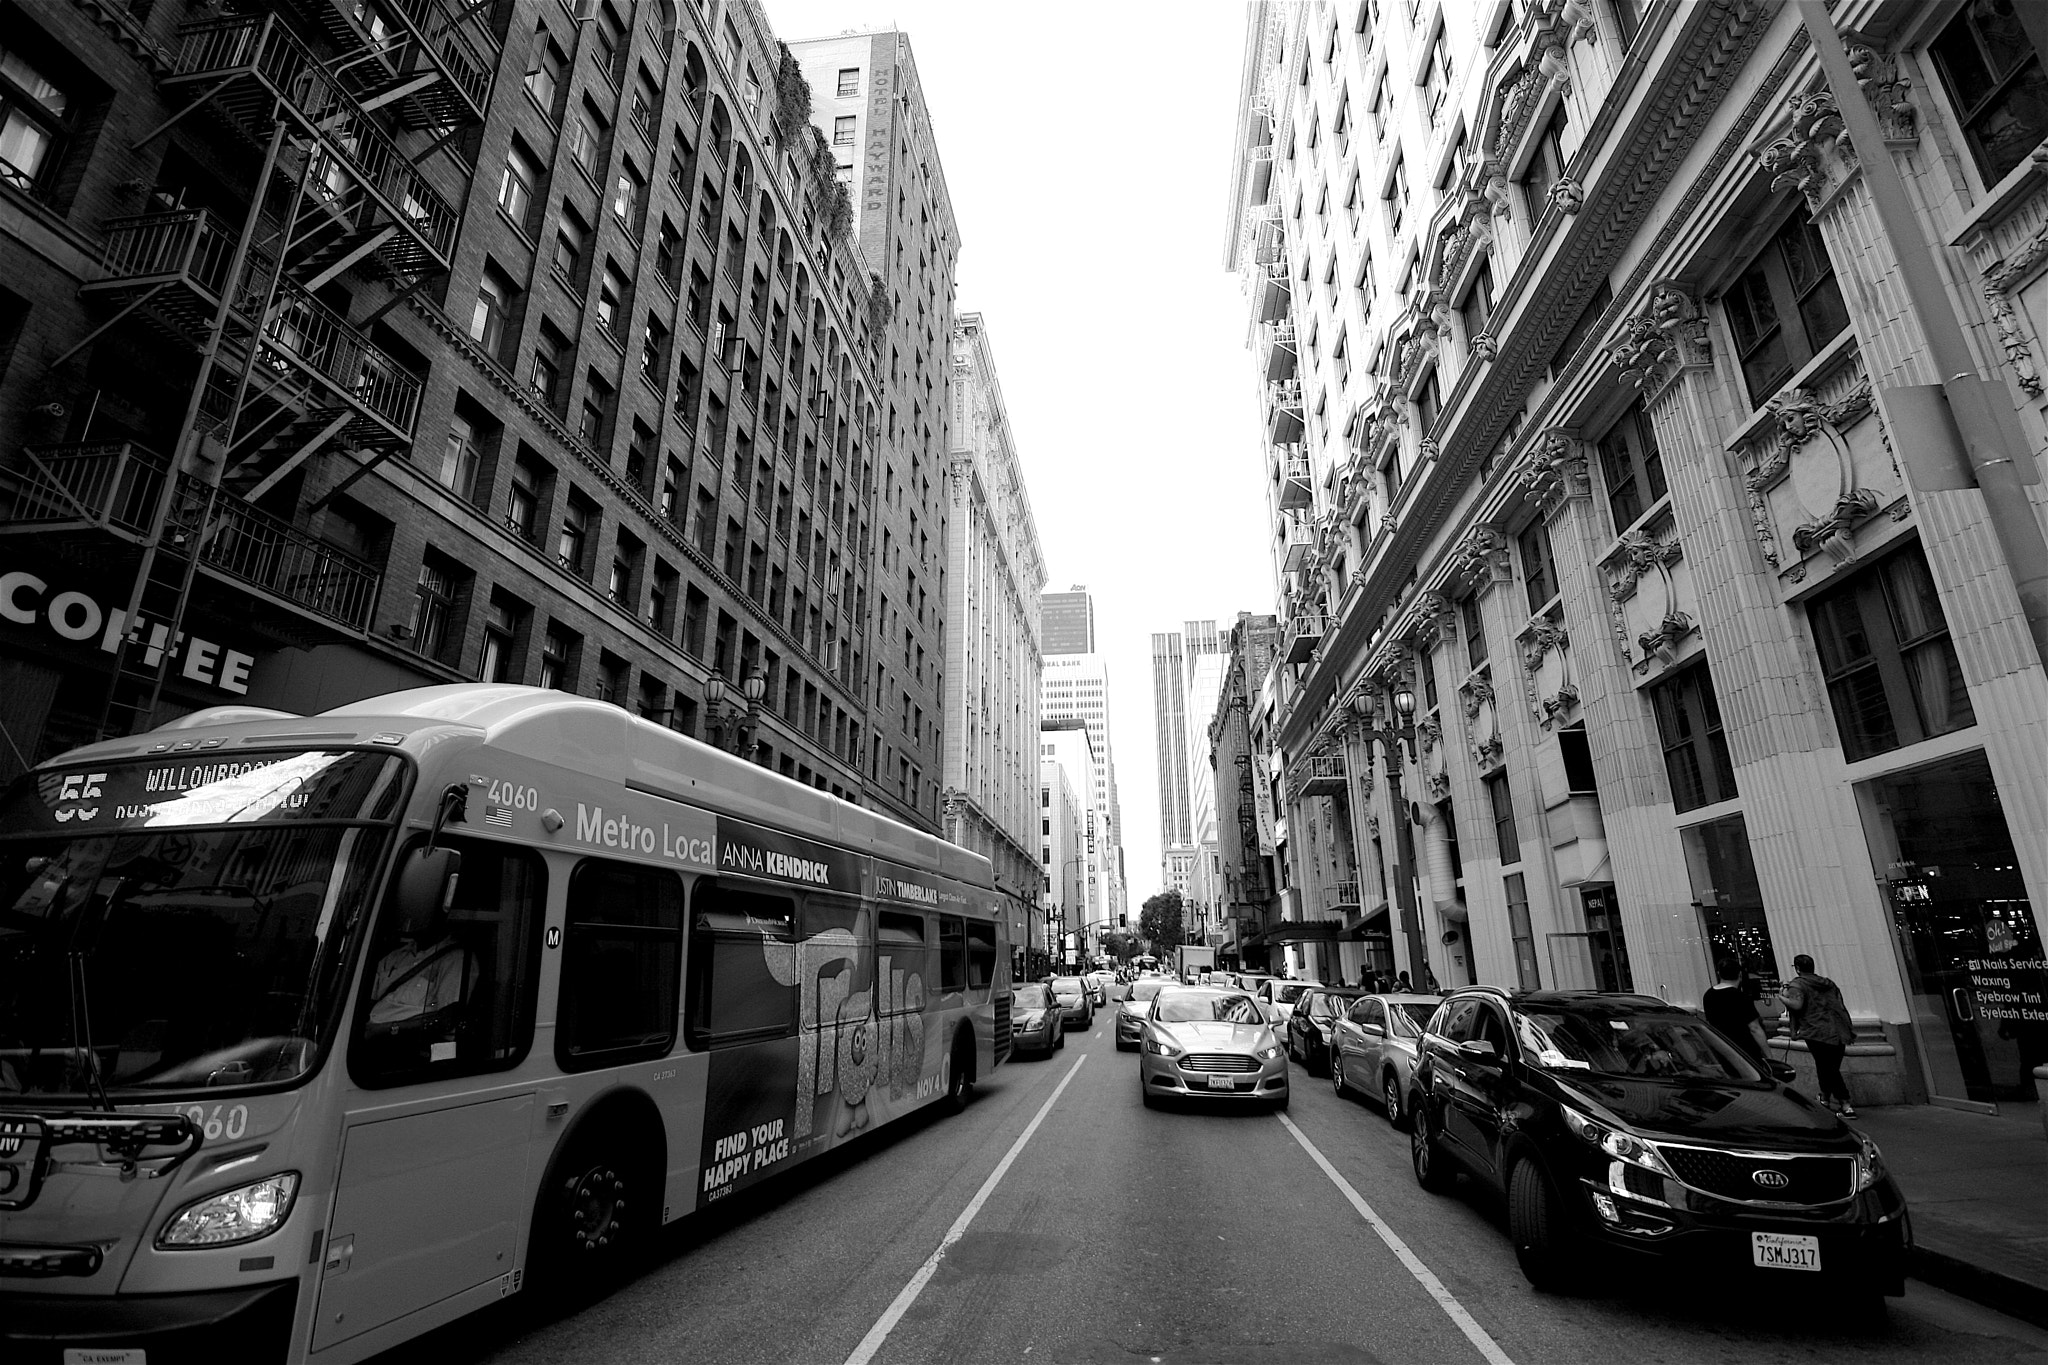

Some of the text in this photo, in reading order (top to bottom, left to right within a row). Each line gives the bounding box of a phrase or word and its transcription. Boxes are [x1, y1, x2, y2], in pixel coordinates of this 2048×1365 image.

[866, 69, 890, 212] HOTEL HAYWARD
[0, 571, 255, 695] COFFEE
[1062, 660, 1081, 668] BANK
[145, 760, 281, 792] WILLOWBRO
[54, 773, 108, 822] 55
[487, 778, 539, 812] 4060
[576, 803, 717, 866] Metro Local
[722, 841, 830, 885] ANNA KENDRICK
[875, 875, 938, 905] JUSTIN TIMBERLAKE
[1896, 884, 1930, 902] OPEN
[548, 929, 559, 946] M
[1982, 959, 2008, 970] Nails
[2009, 957, 2048, 970] Service
[1971, 974, 2011, 989] Waxing
[1976, 990, 2042, 1004] Eyebrow Tint
[1980, 1006, 2020, 1020] Eyelash
[916, 1073, 940, 1100] NOV 4
[172, 1103, 249, 1140] 060
[714, 1131, 748, 1162] FIND
[751, 1118, 784, 1148] YOUR
[703, 1152, 752, 1192] HAPPY
[753, 1137, 790, 1171] PLACE
[708, 1183, 733, 1202] CA37363
[1758, 1173, 1785, 1186] KIA
[1765, 1234, 1807, 1247] California
[1757, 1245, 1816, 1266] 7SMJ317
